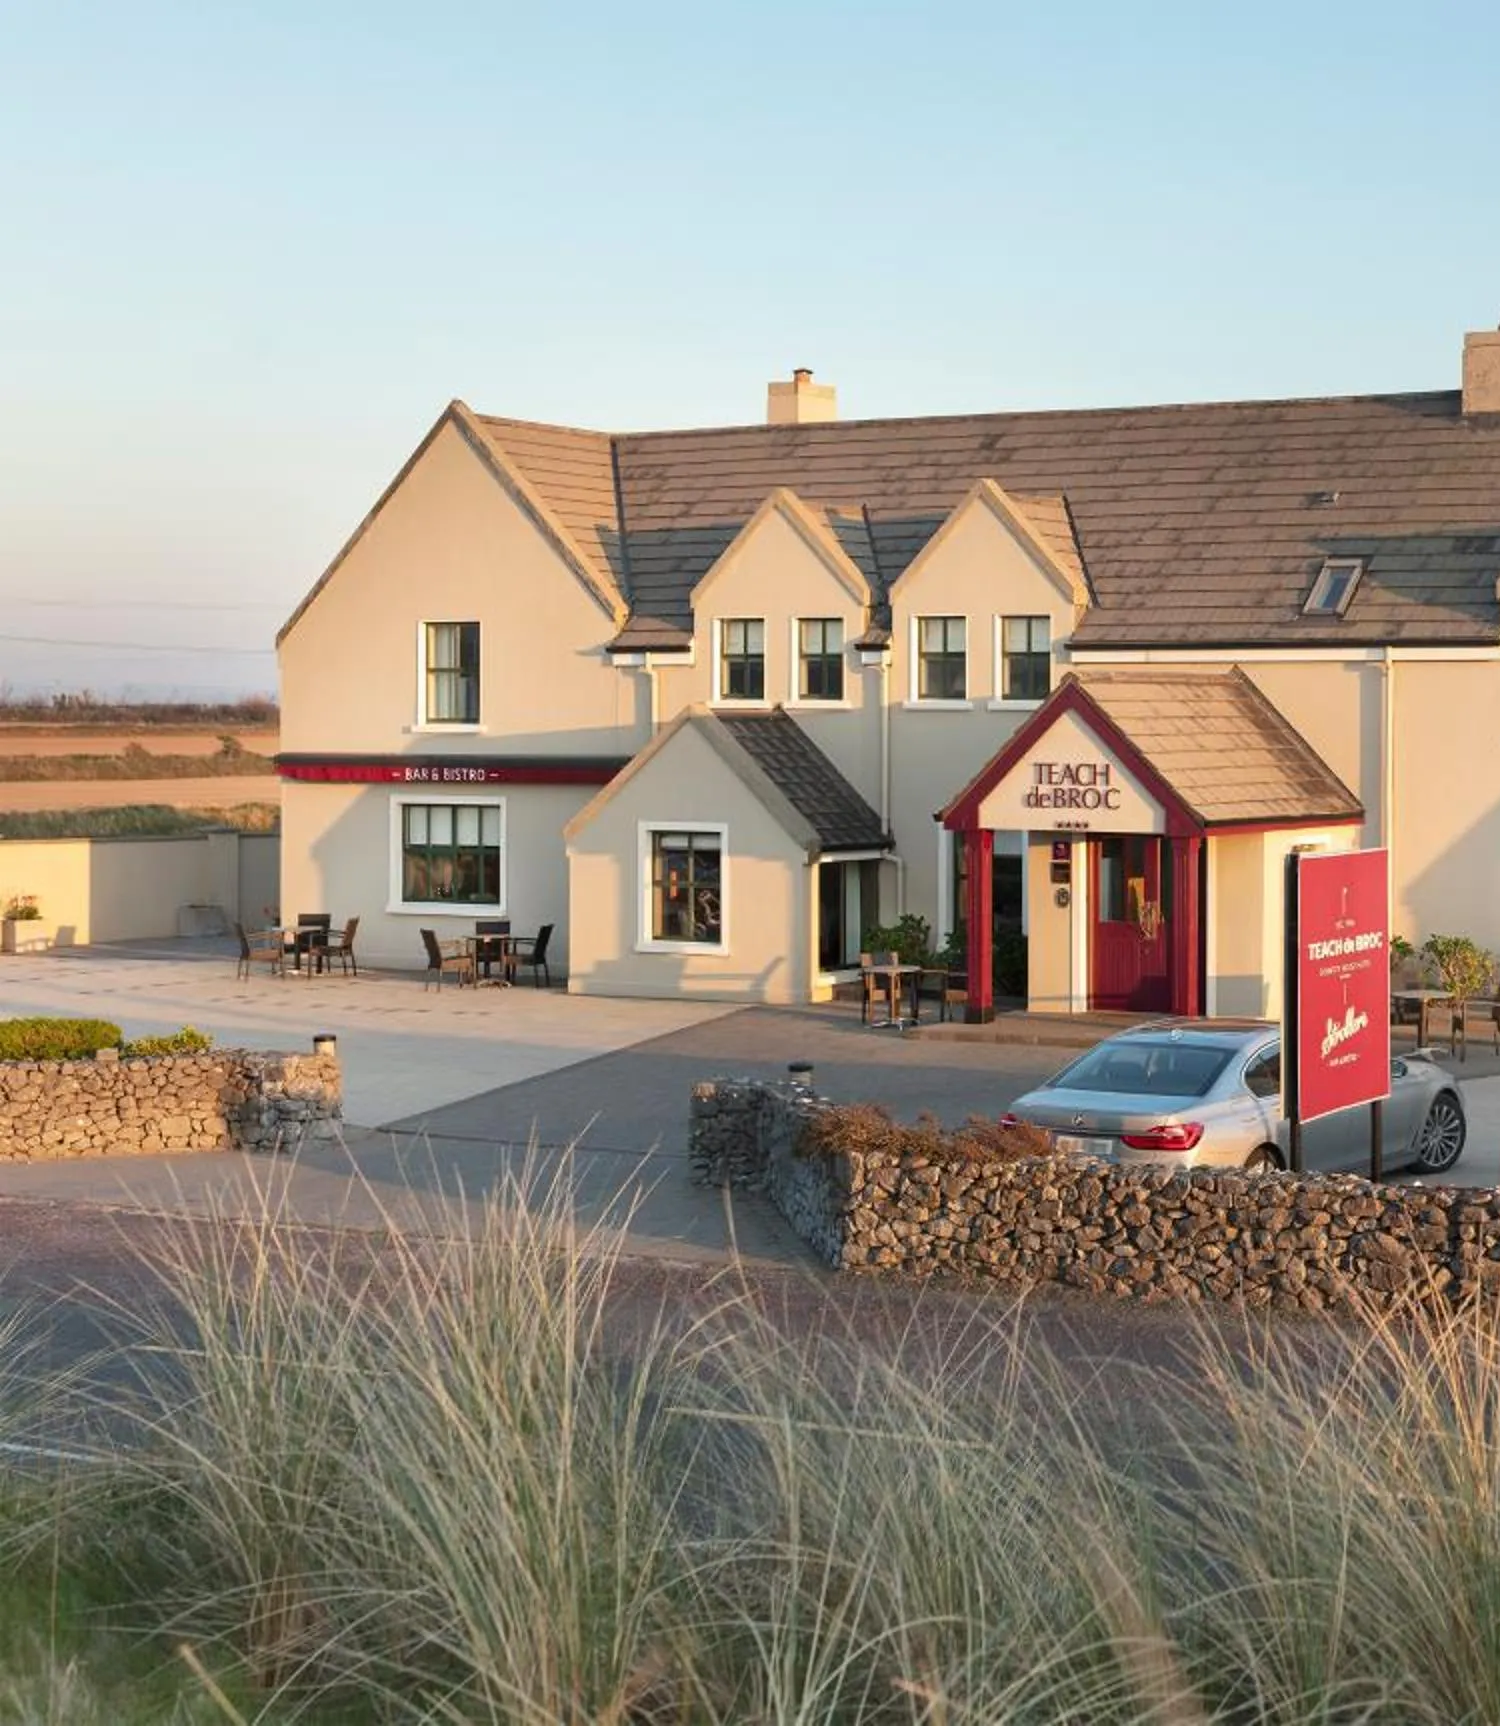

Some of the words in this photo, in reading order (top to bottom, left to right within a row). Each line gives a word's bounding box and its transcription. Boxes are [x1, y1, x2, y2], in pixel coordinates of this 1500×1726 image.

[405, 767, 429, 781] BAR
[443, 767, 485, 781] BISTRO
[1034, 763, 1110, 785] TEACH
[1308, 936, 1342, 960] TEACH
